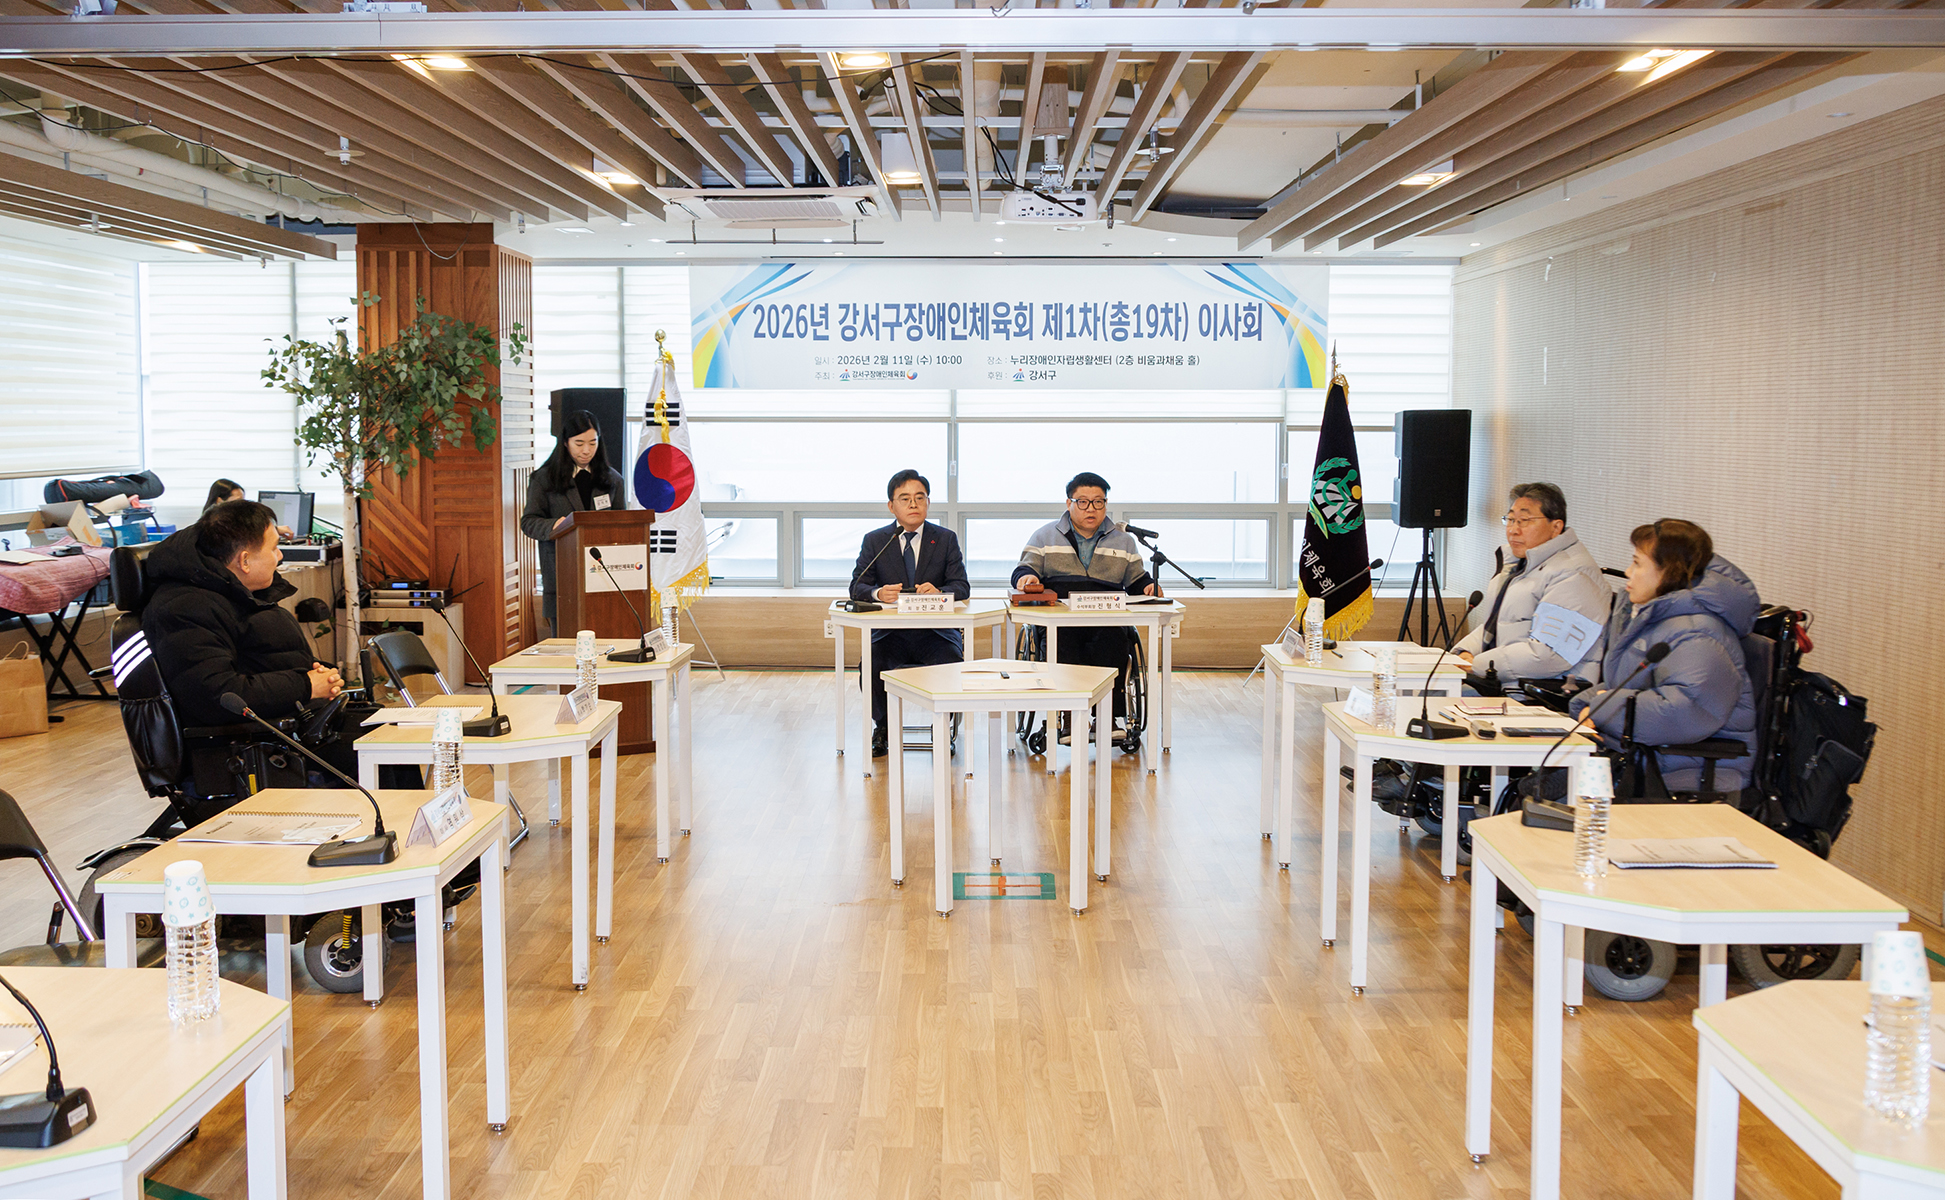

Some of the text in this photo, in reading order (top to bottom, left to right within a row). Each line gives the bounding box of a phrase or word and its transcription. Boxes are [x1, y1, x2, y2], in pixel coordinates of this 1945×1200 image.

[753, 301, 1263, 342] 2026년 강서구장애인체육회 제1차(총19차) 이사회
[814, 355, 830, 366] 일시
[837, 355, 870, 366] 2026년
[873, 355, 889, 366] 2월
[893, 355, 913, 366] 11일
[916, 355, 933, 366] (수)
[936, 355, 963, 366] 10:00
[1010, 355, 1112, 366] 누리장애인자립생활센터
[1115, 355, 1135, 367] (2층
[1138, 355, 1184, 366] 비움과채움
[1187, 355, 1201, 367] 홀)
[814, 370, 831, 381] 주최
[852, 370, 906, 379] 강서구장애인체육회
[987, 370, 1003, 381] 후원
[1029, 370, 1057, 381] 강서구
